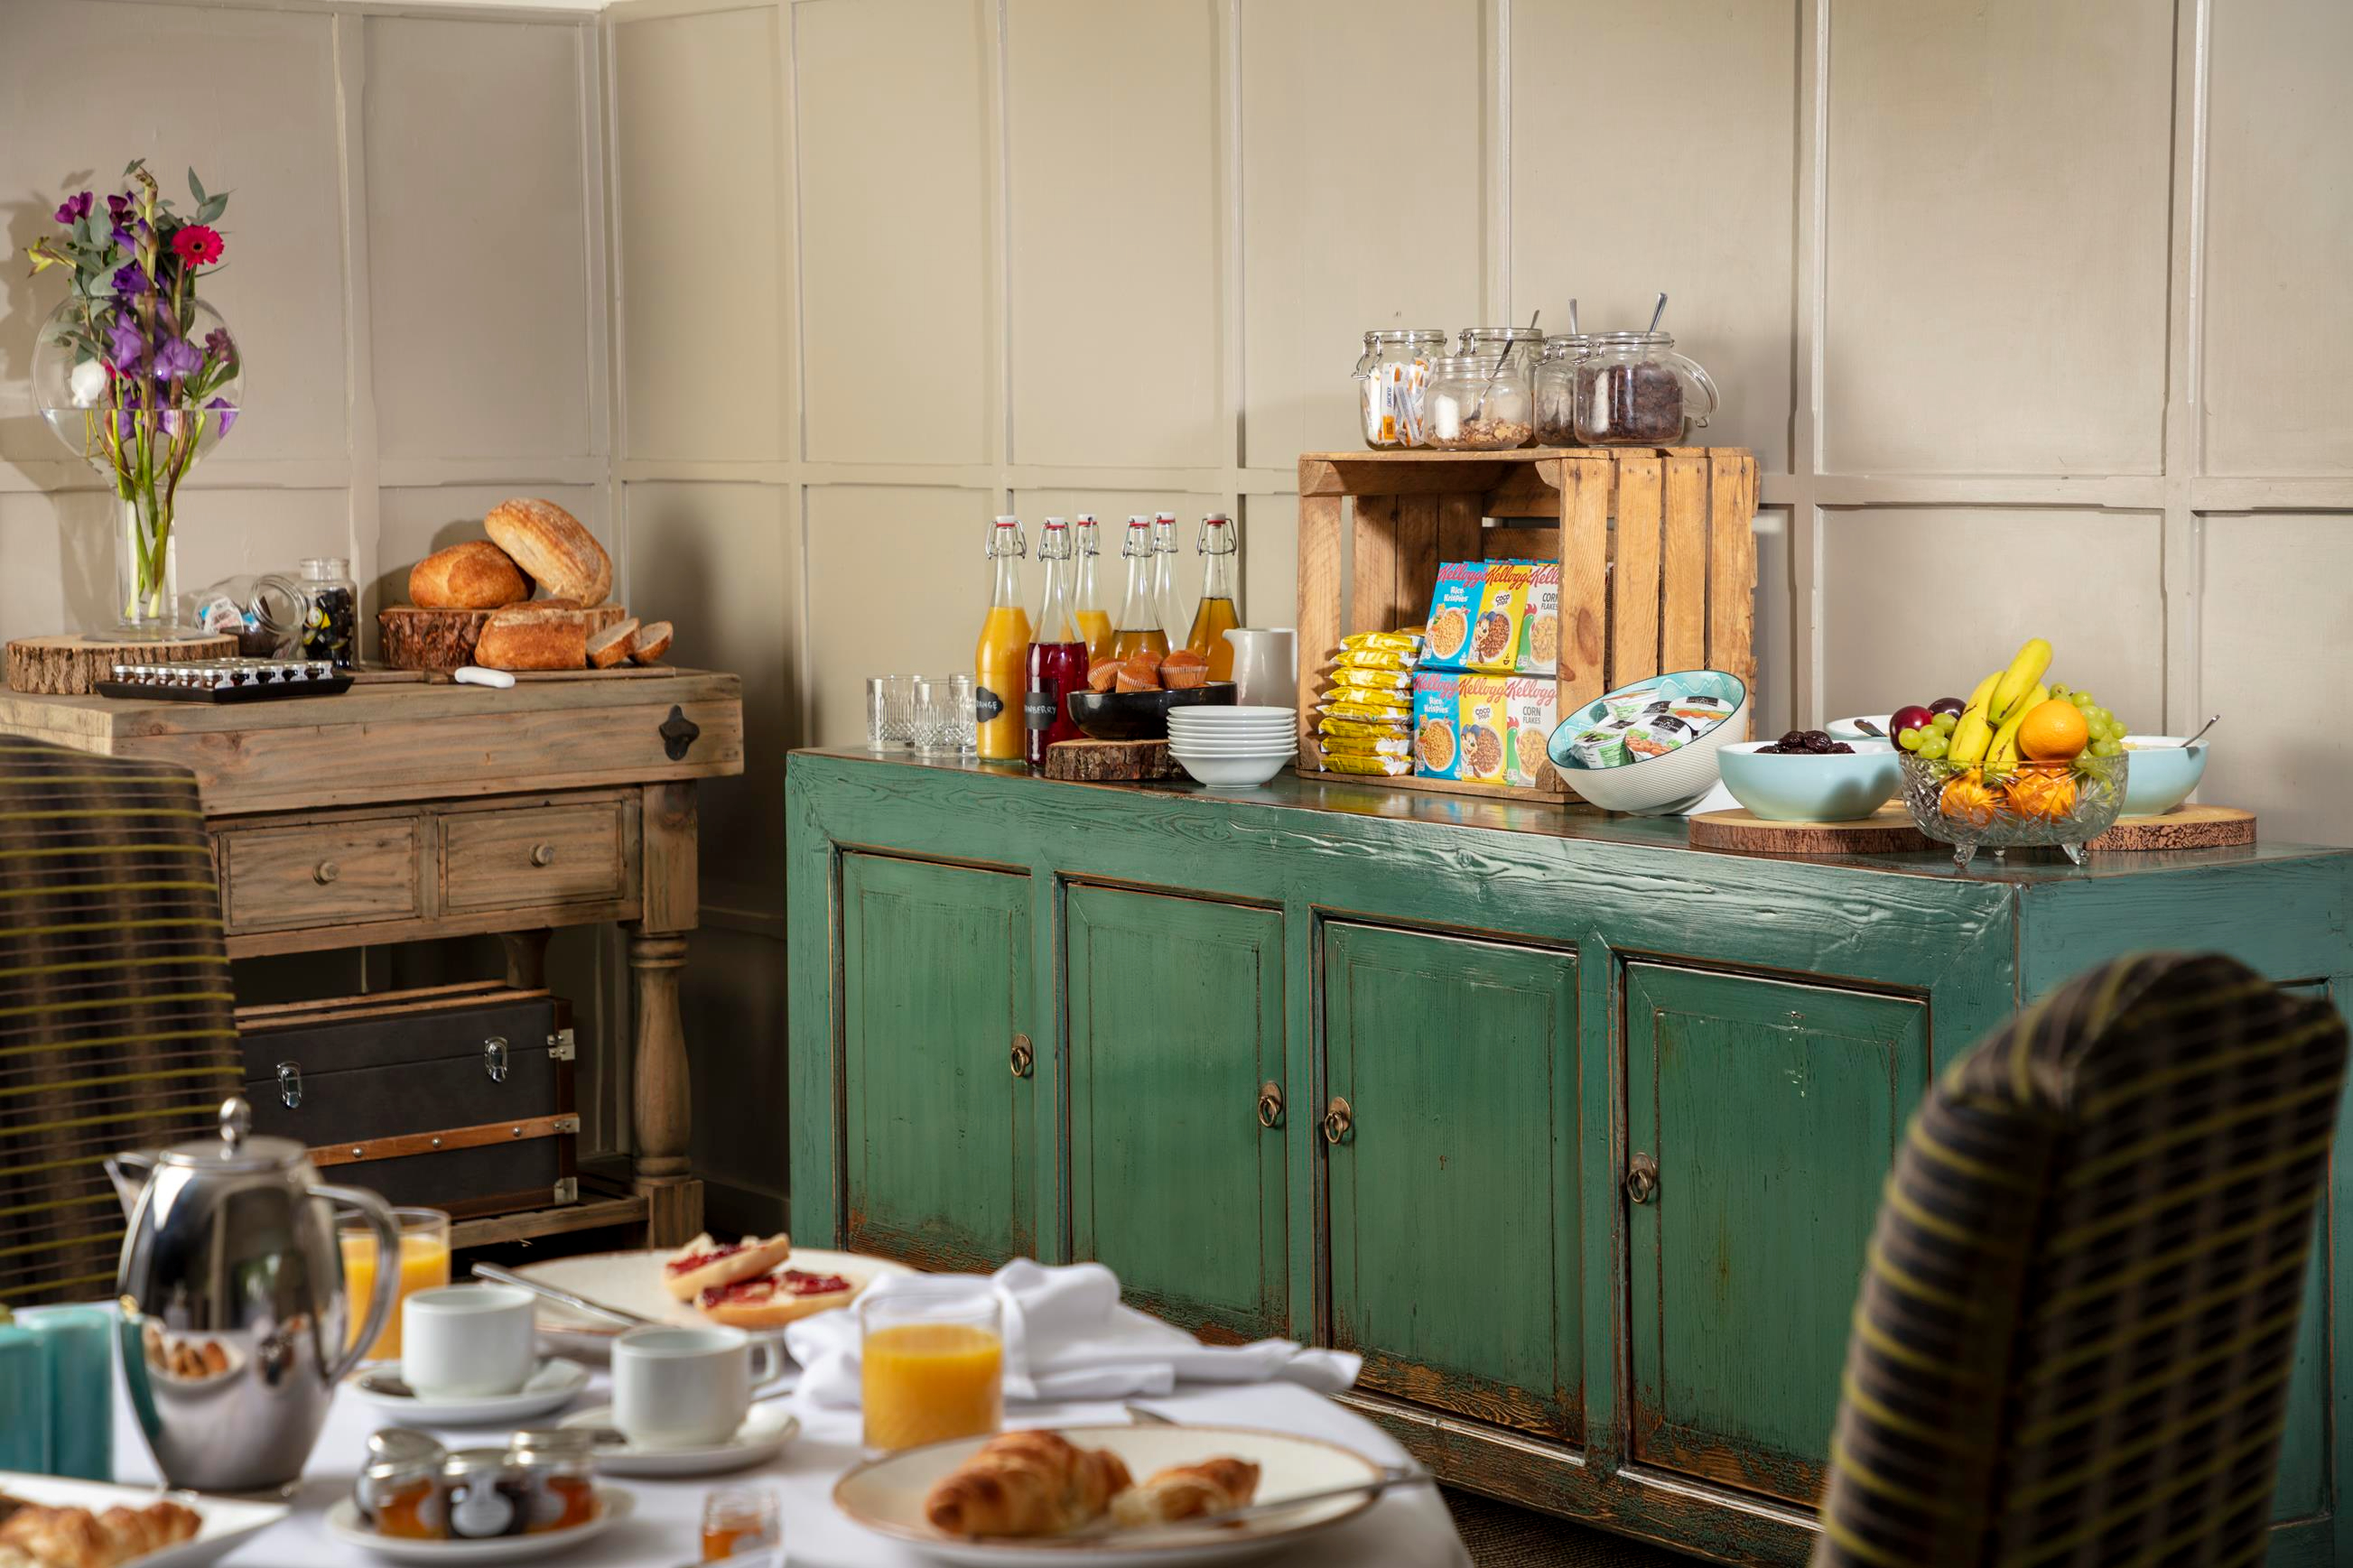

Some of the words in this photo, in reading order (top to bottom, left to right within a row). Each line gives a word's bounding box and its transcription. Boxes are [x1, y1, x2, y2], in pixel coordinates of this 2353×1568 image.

[1413, 673, 1459, 700] Kellogg
[1505, 678, 1558, 706] Kellogg
[976, 700, 998, 711] RANGE
[1522, 706, 1541, 717] CORN
